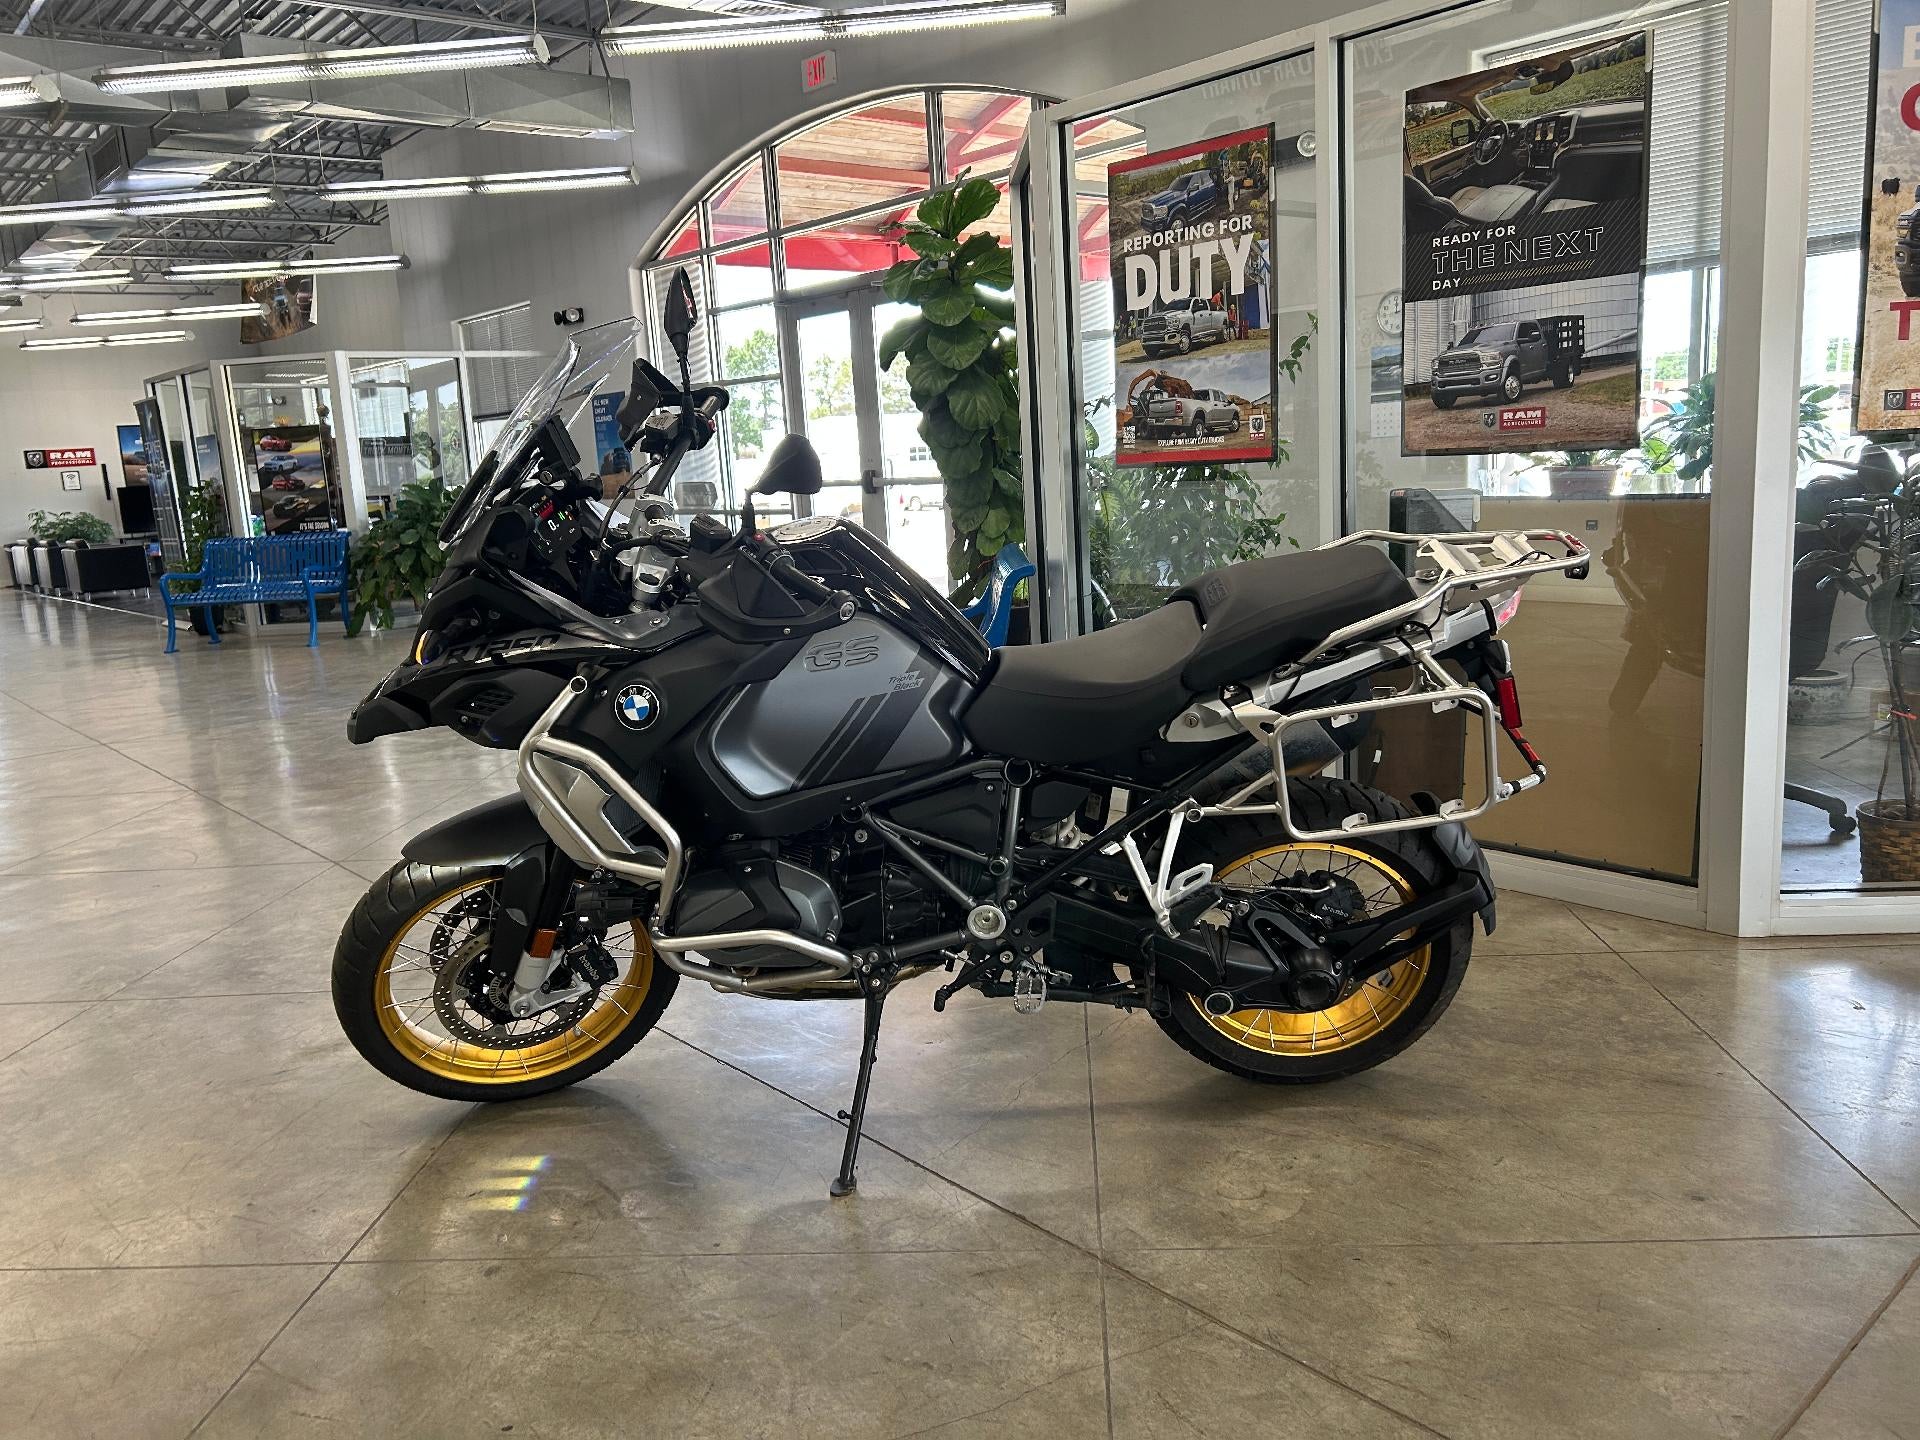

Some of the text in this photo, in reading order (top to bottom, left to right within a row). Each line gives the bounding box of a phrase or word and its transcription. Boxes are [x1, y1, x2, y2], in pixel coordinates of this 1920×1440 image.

[807, 55, 827, 87] EXIT
[1123, 214, 1253, 253] REPORTING FOR
[1432, 225, 1516, 248] READY FOR
[1432, 226, 1604, 275] THE NEXT
[1125, 232, 1254, 312] DUTY
[1432, 277, 1461, 291] DAY
[1502, 409, 1542, 419] RAM
[1502, 419, 1542, 427] AGRICULTURE
[49, 450, 92, 459] RAM
[803, 635, 880, 673] GS
[888, 673, 915, 684] Triple
[893, 680, 921, 691] Black
[618, 687, 652, 704] BMW
